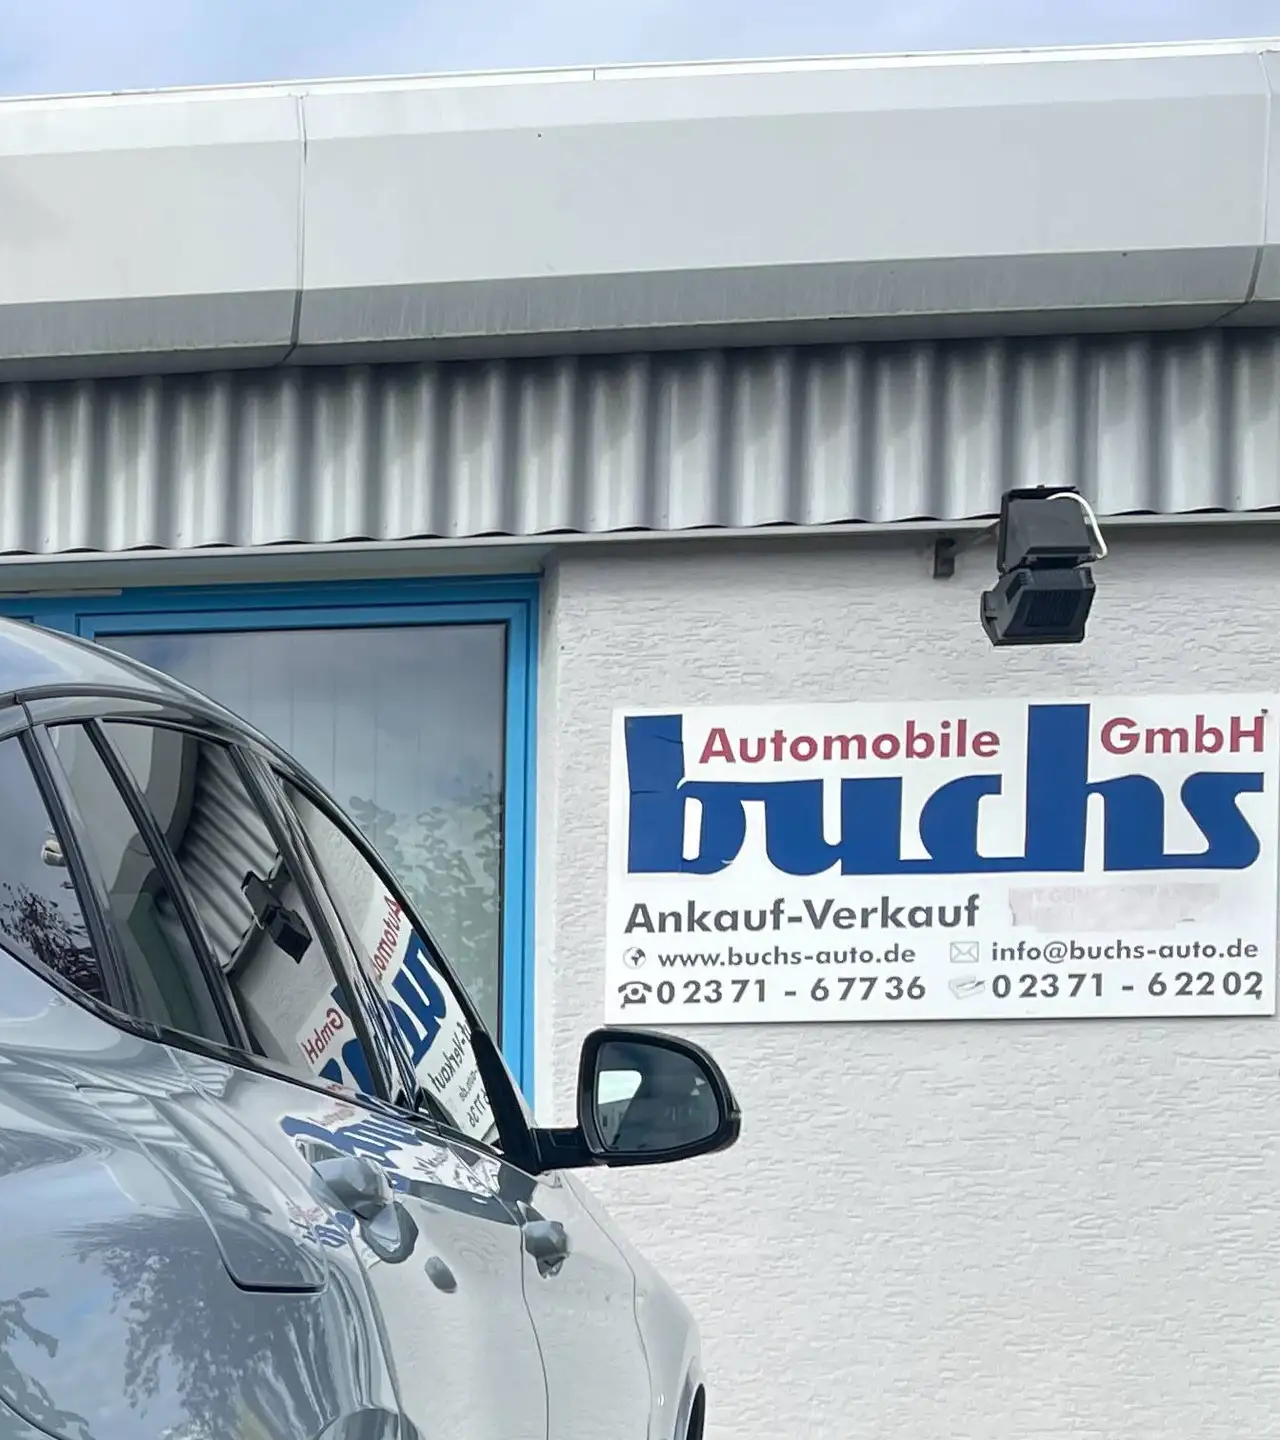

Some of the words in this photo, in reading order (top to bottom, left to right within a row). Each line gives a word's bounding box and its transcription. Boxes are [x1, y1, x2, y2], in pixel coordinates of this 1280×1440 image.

[699, 719, 1002, 765] Automobile
[1100, 715, 1265, 754] GmbH
[624, 703, 1265, 876] buchs
[623, 892, 980, 935] Ankauf-Verkauf
[657, 943, 916, 967] www.buchs-auto.de
[991, 938, 1259, 964] info@buchs-auto.de
